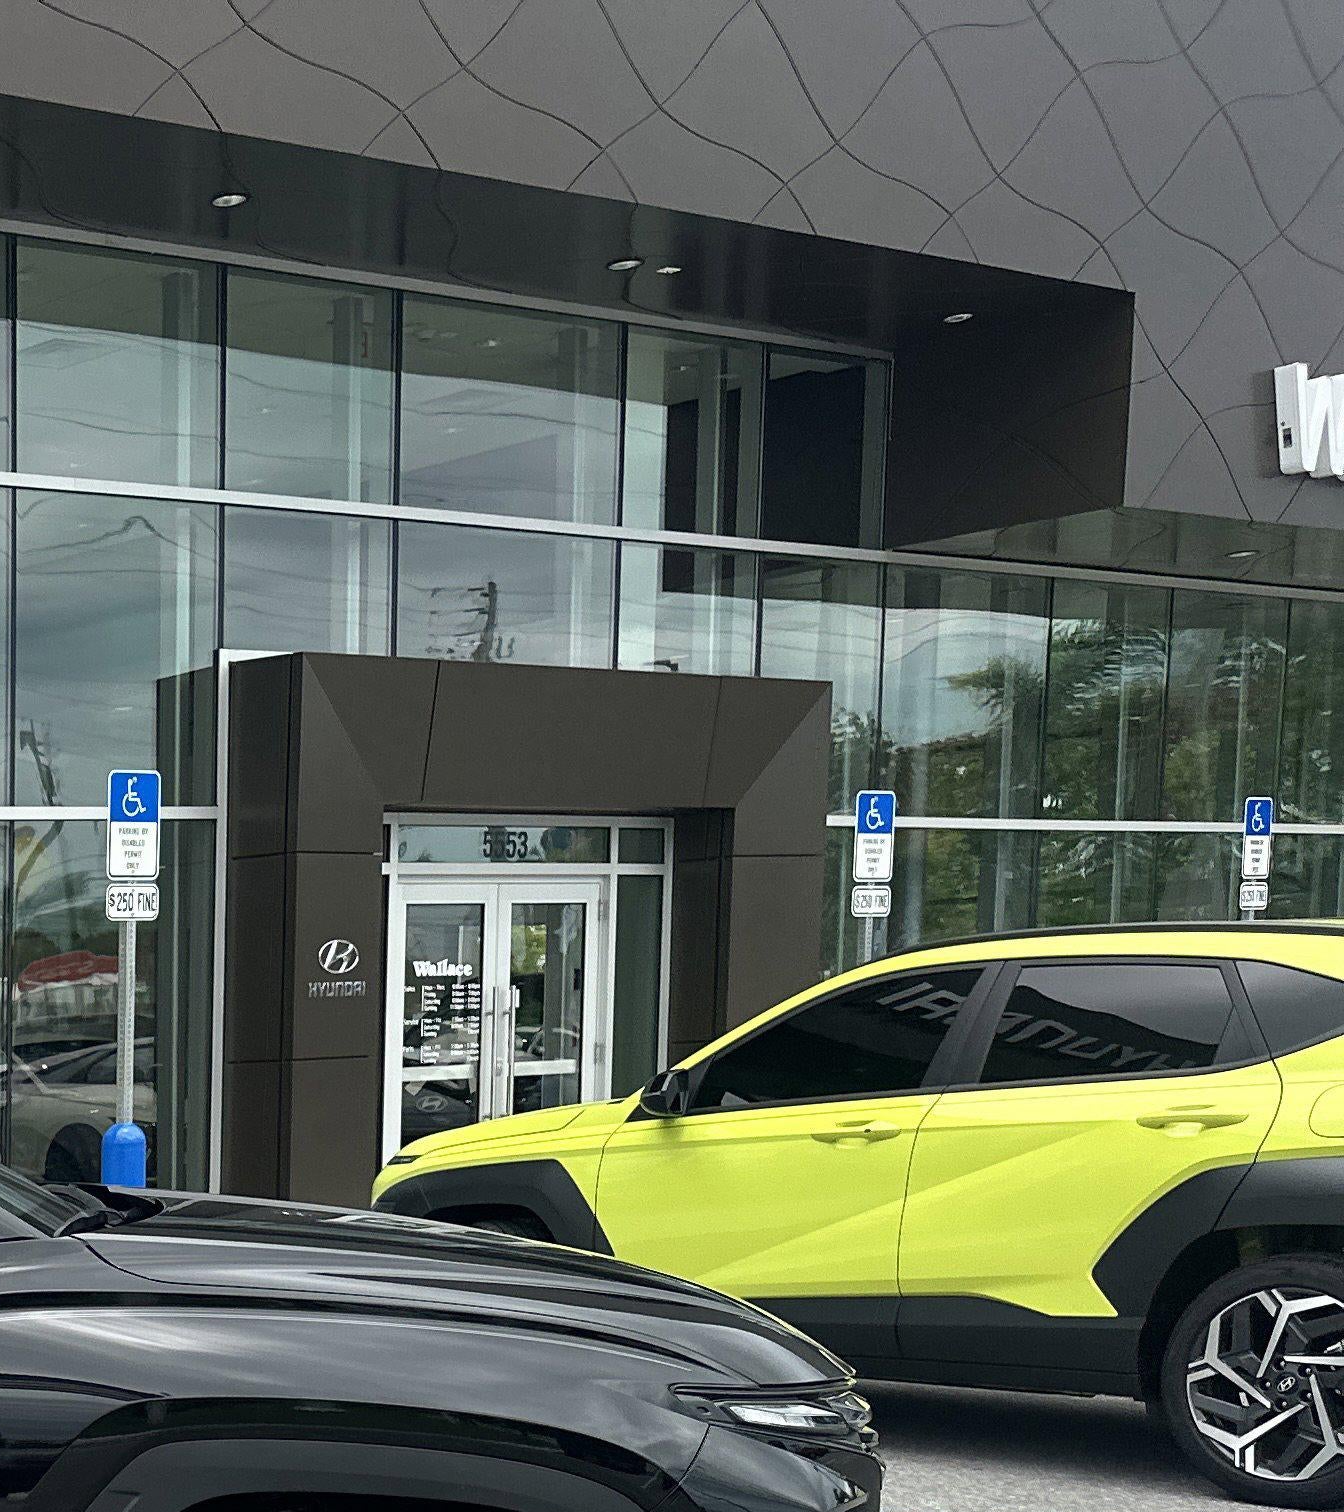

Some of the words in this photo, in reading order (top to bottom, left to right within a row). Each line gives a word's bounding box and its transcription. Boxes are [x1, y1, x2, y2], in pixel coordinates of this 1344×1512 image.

[109, 893, 134, 911] $250
[138, 893, 157, 911] FINE
[413, 958, 473, 977] Wallace
[308, 981, 367, 998] HYUNDAI
